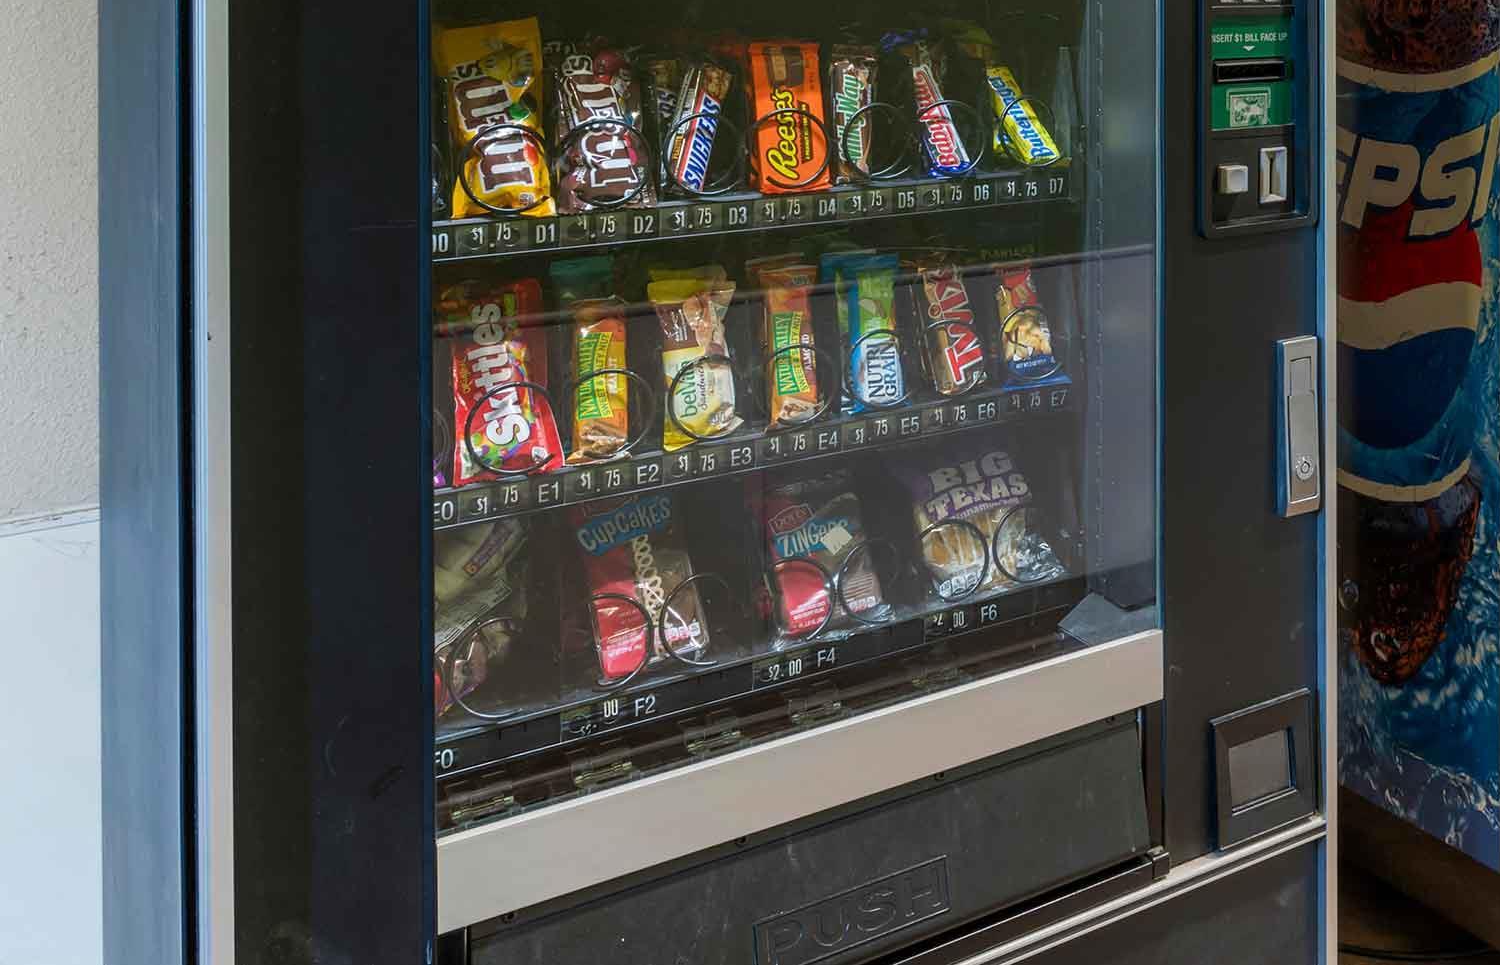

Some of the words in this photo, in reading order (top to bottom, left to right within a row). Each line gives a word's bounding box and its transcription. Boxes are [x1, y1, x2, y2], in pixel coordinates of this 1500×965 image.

[1245, 33, 1259, 43] BILL
[1260, 32, 1277, 42] FACE
[974, 184, 989, 201] D6
[1049, 178, 1064, 195] D7
[819, 198, 836, 216] D4
[899, 188, 915, 207] D5
[634, 216, 654, 234] D2
[729, 207, 747, 224] D3
[536, 224, 555, 243] D1
[467, 303, 530, 445] Skittles
[867, 342, 885, 398] NUTRI
[880, 340, 898, 397] GRAIN
[1051, 390, 1067, 405] E7
[978, 402, 995, 419] E6
[901, 417, 919, 433] E5
[818, 431, 838, 449] E4
[731, 447, 751, 466] E3
[637, 464, 658, 483] E2
[928, 451, 1012, 493] BIG
[538, 483, 559, 502] E1
[926, 473, 1029, 521] TEXAS
[981, 605, 997, 623] F6
[817, 647, 836, 667] F4
[635, 696, 655, 716] F2
[765, 867, 944, 965] PUSH
